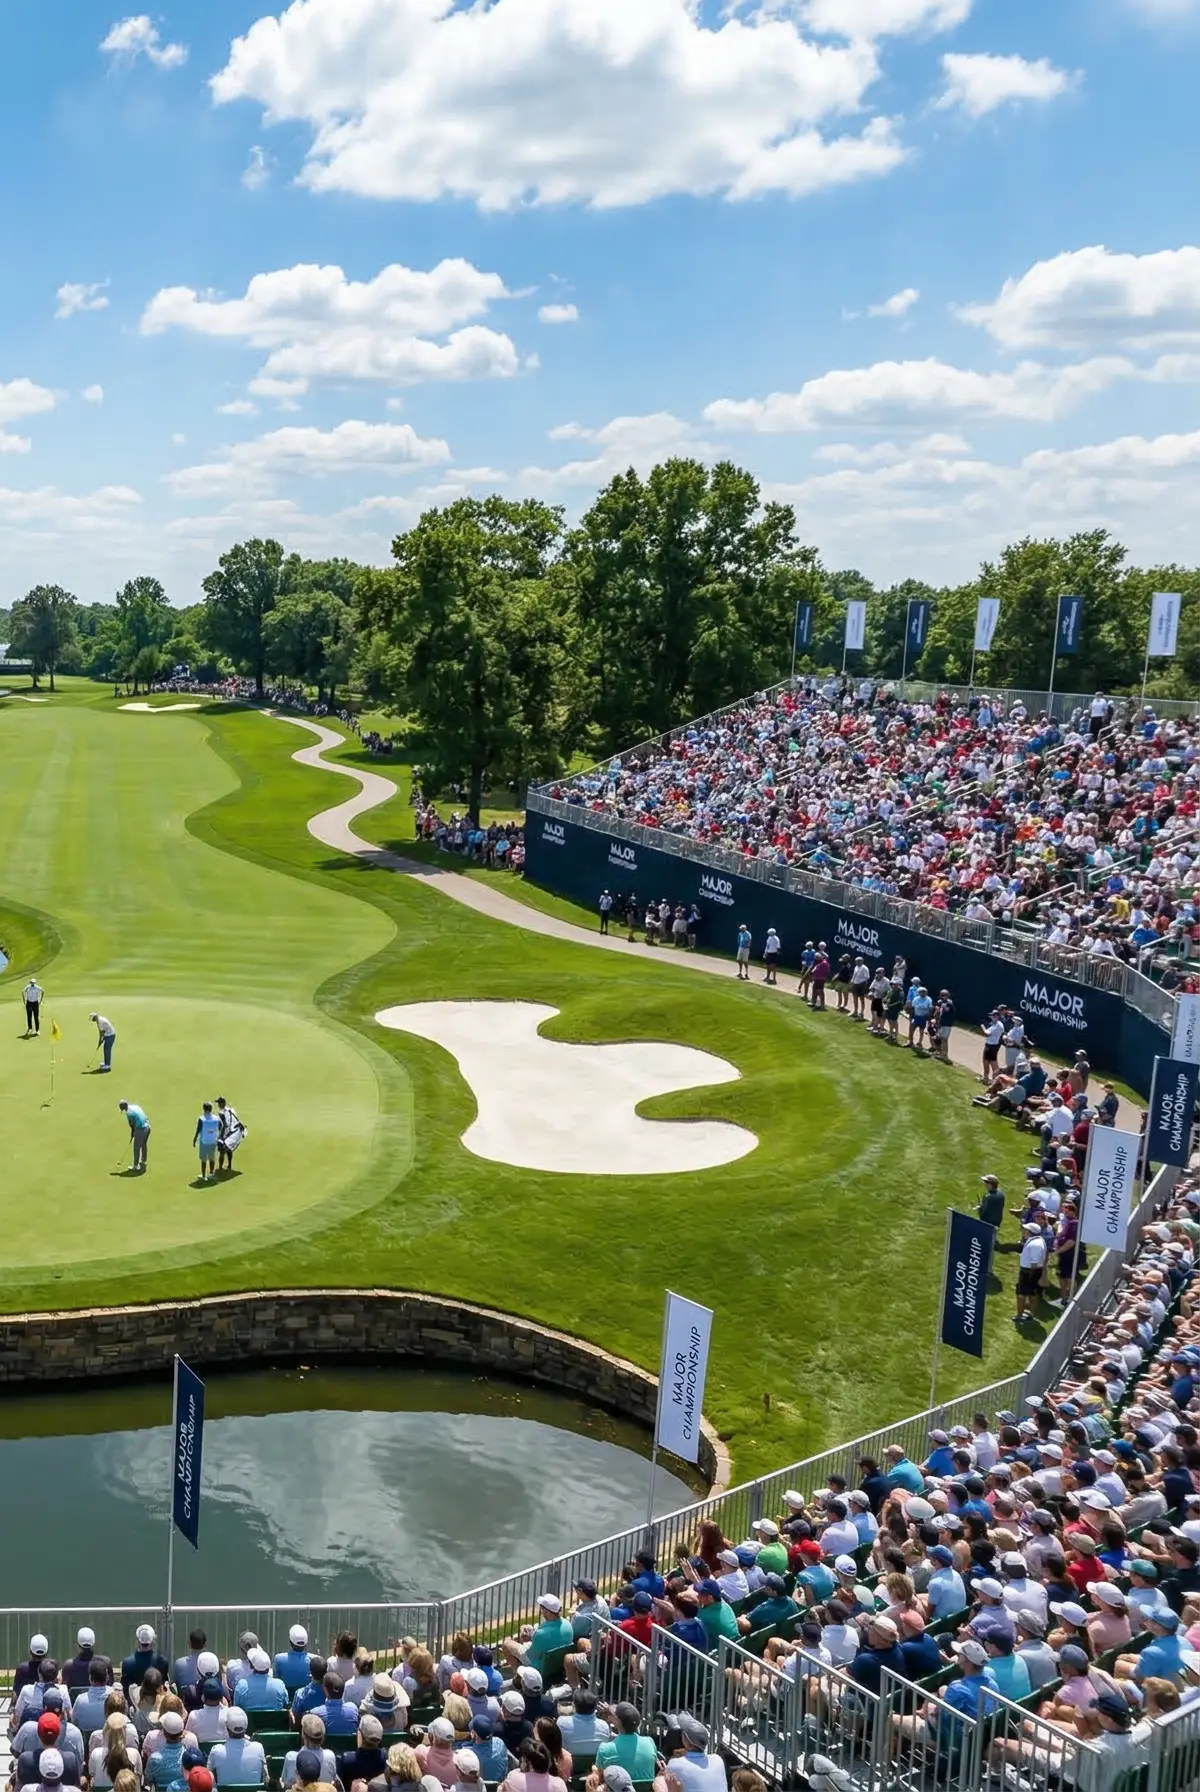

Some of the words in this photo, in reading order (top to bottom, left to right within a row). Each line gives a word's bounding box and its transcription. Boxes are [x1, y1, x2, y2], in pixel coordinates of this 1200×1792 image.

[701, 874, 733, 896] MAJOR
[837, 918, 880, 947] MAJOR
[1023, 979, 1084, 1017] MAJOR
[1159, 1093, 1174, 1131] MAJOR
[1094, 1168, 1111, 1210] MAJOR
[1106, 1146, 1128, 1234] CHAMPIONSHIP
[953, 1261, 968, 1308] MAJOR
[672, 1352, 687, 1406] MAJOR
[682, 1326, 702, 1440] CHAMPIONSHIP
